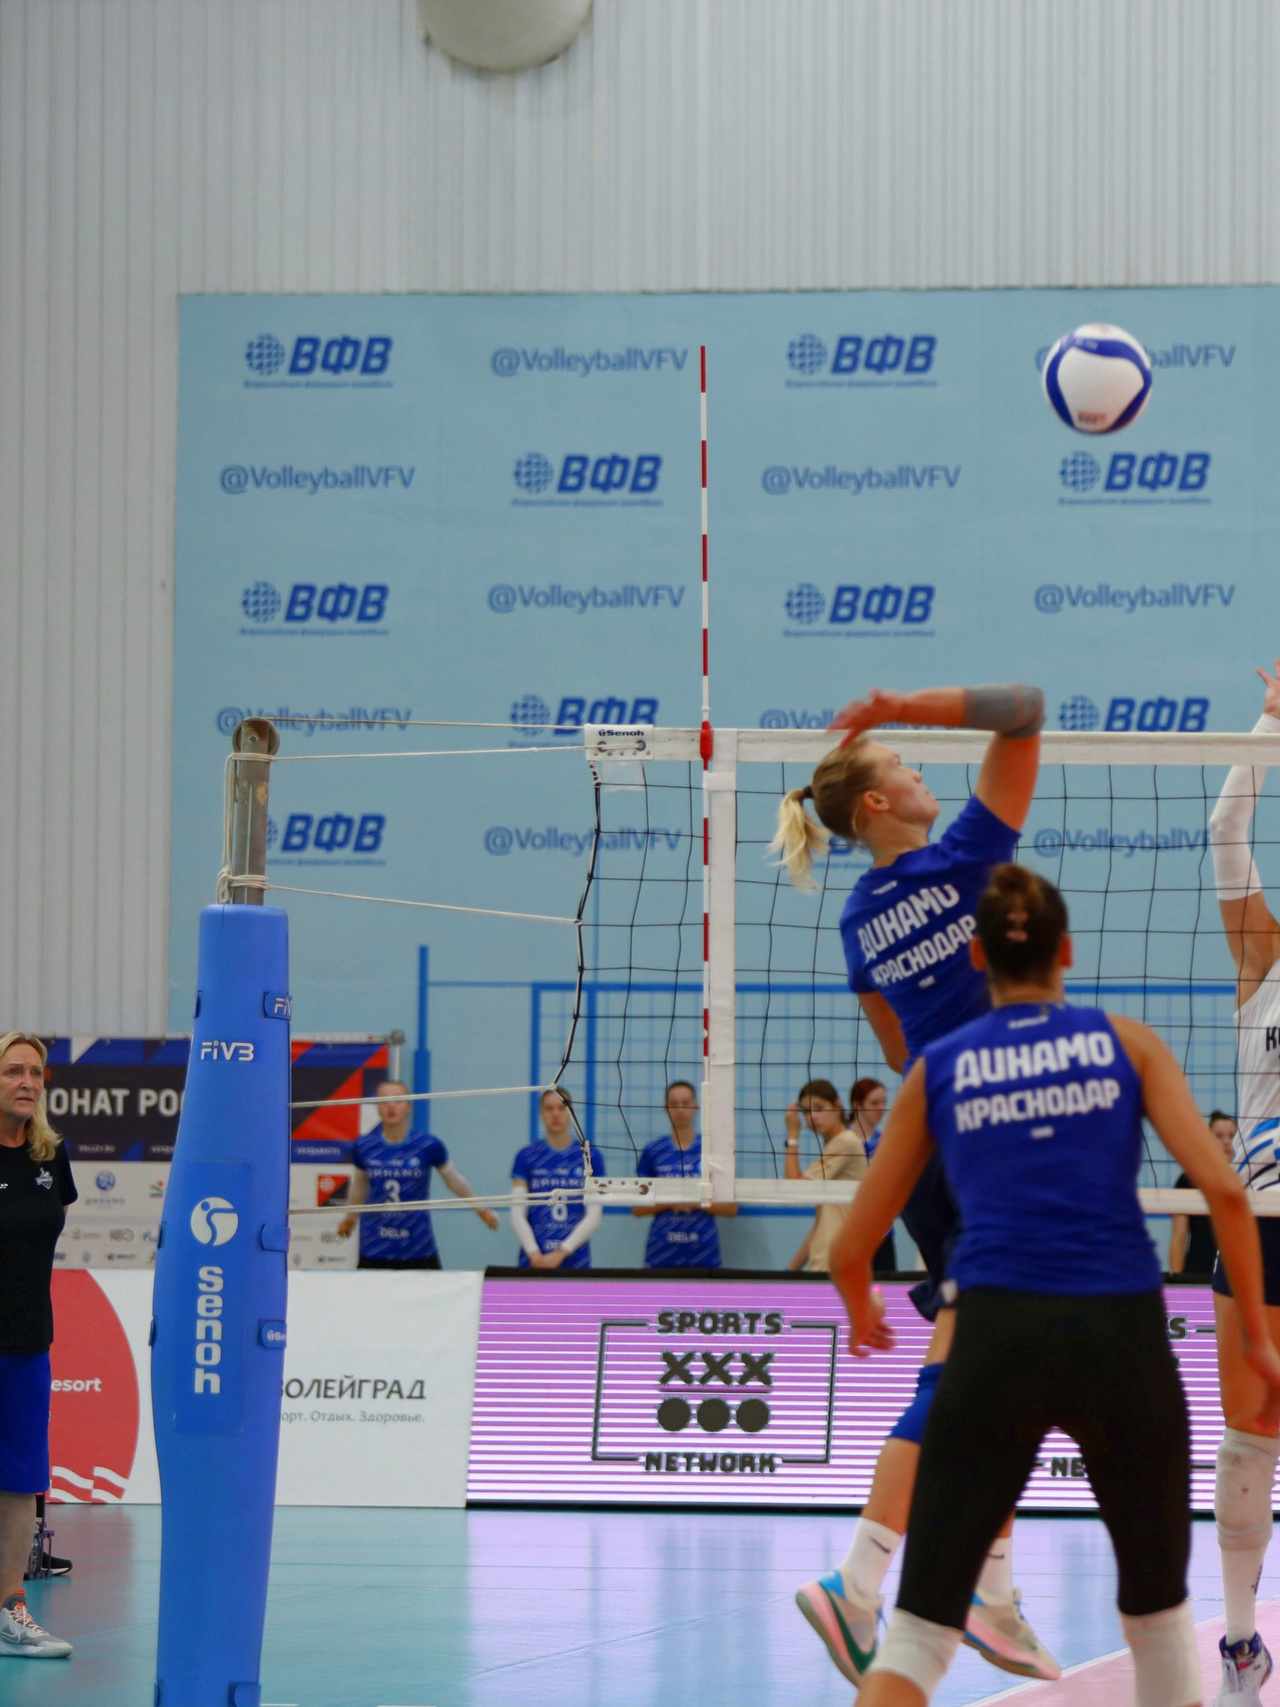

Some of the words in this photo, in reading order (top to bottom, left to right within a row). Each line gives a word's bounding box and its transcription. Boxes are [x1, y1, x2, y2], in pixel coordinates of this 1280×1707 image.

[289, 334, 392, 376] ВФВ
[490, 346, 688, 377] @VolleyballVFV
[831, 333, 937, 375] ВФВ
[220, 465, 415, 496] @VolleyballVFV
[557, 453, 662, 493] ВФВ
[761, 466, 960, 496] @VolleyballVFV
[1104, 452, 1211, 491] ВФВ
[284, 583, 389, 623] ВФВ
[486, 584, 685, 614] @VolleyballVFV
[829, 584, 935, 624] ВФВ
[1034, 584, 1235, 614] @VolleyballVFV
[554, 697, 659, 736] ВФВ
[1104, 696, 1210, 732] ВФВ
[282, 813, 387, 853] ВФВ
[483, 825, 683, 857] @VolleyballVFV
[954, 1031, 1116, 1093] ДИНАМО
[955, 1078, 1121, 1133] КРАСНОДАР
[656, 1310, 783, 1335] SPORTS
[644, 1452, 777, 1474] NETWORK
